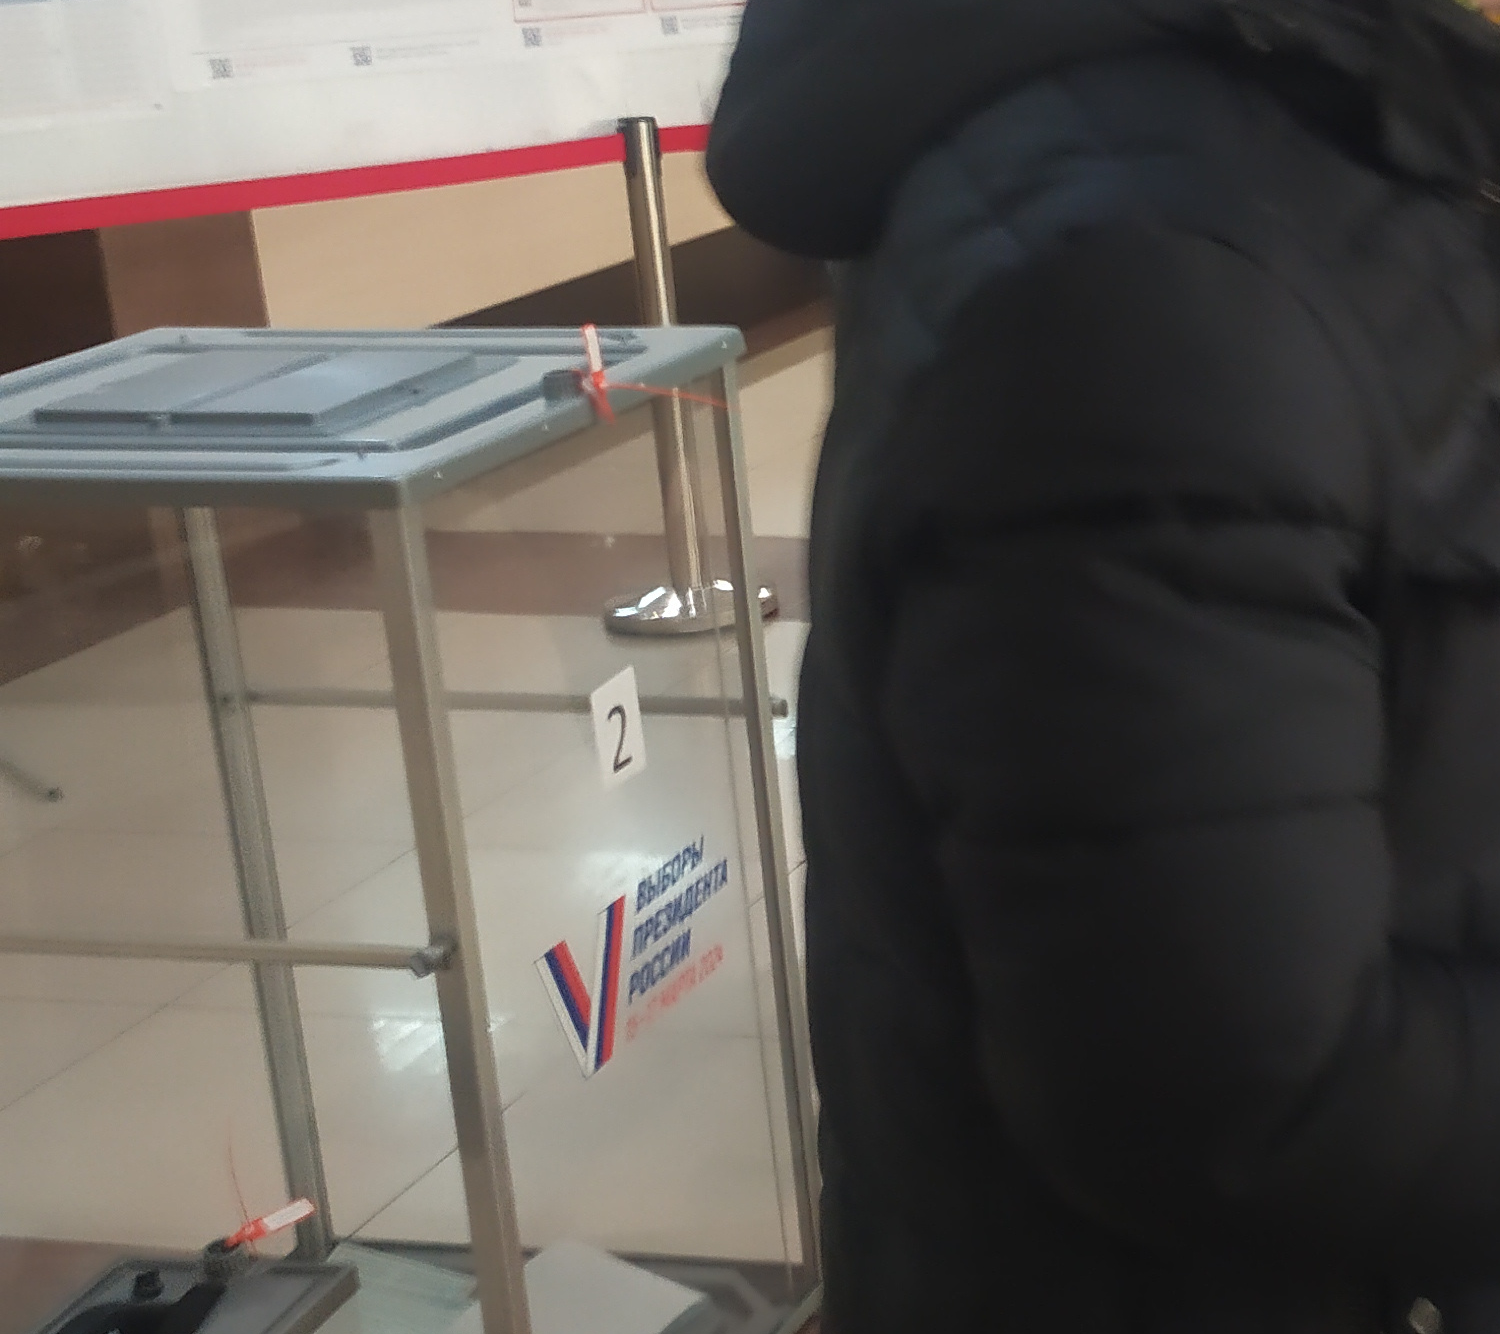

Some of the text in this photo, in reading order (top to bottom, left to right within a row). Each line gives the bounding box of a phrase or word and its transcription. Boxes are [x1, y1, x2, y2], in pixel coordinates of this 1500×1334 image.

[608, 704, 633, 774] 2
[631, 858, 728, 961] ПРЕЗИДЕНТА
[636, 835, 704, 914] ВЫБОРЫ
[628, 928, 691, 1005] РОССИИ
